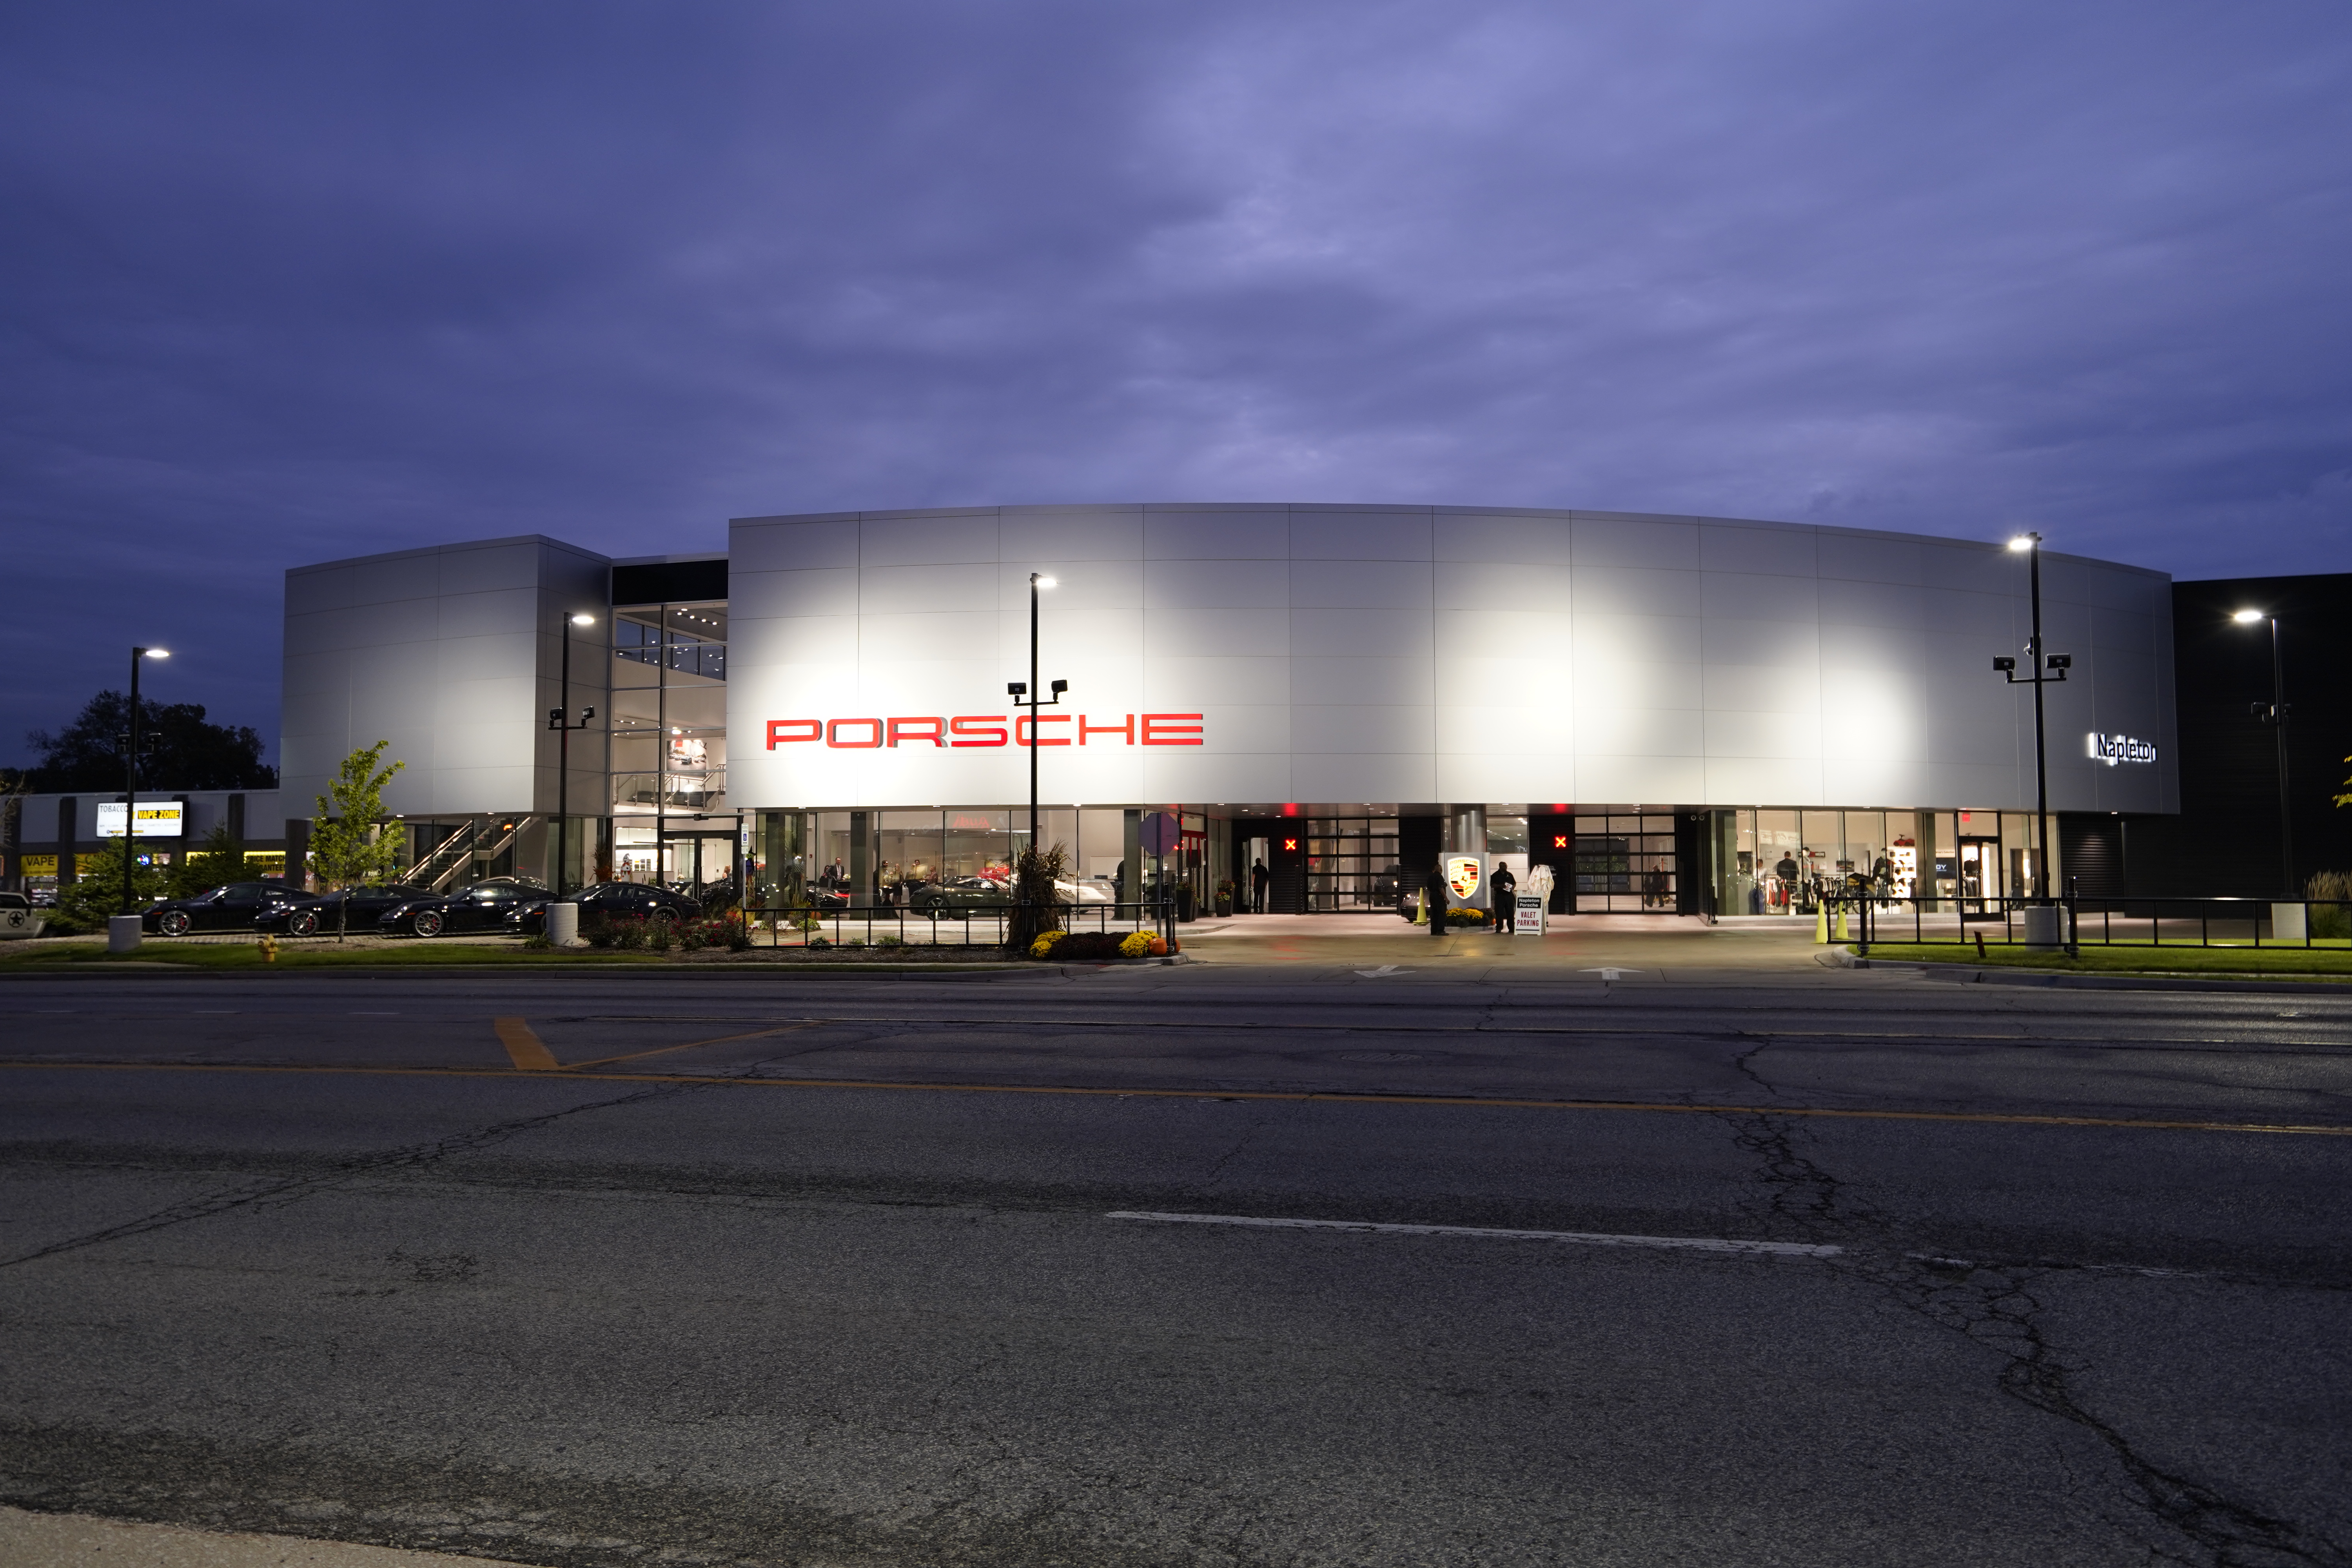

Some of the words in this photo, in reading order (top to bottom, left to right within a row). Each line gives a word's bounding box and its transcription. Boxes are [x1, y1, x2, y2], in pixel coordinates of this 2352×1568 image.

[766, 713, 1203, 751] PORSCHE
[2097, 733, 2158, 764] Napleton
[138, 810, 157, 819] VAPE
[159, 810, 180, 819] ZONE
[26, 857, 54, 866] VAPE
